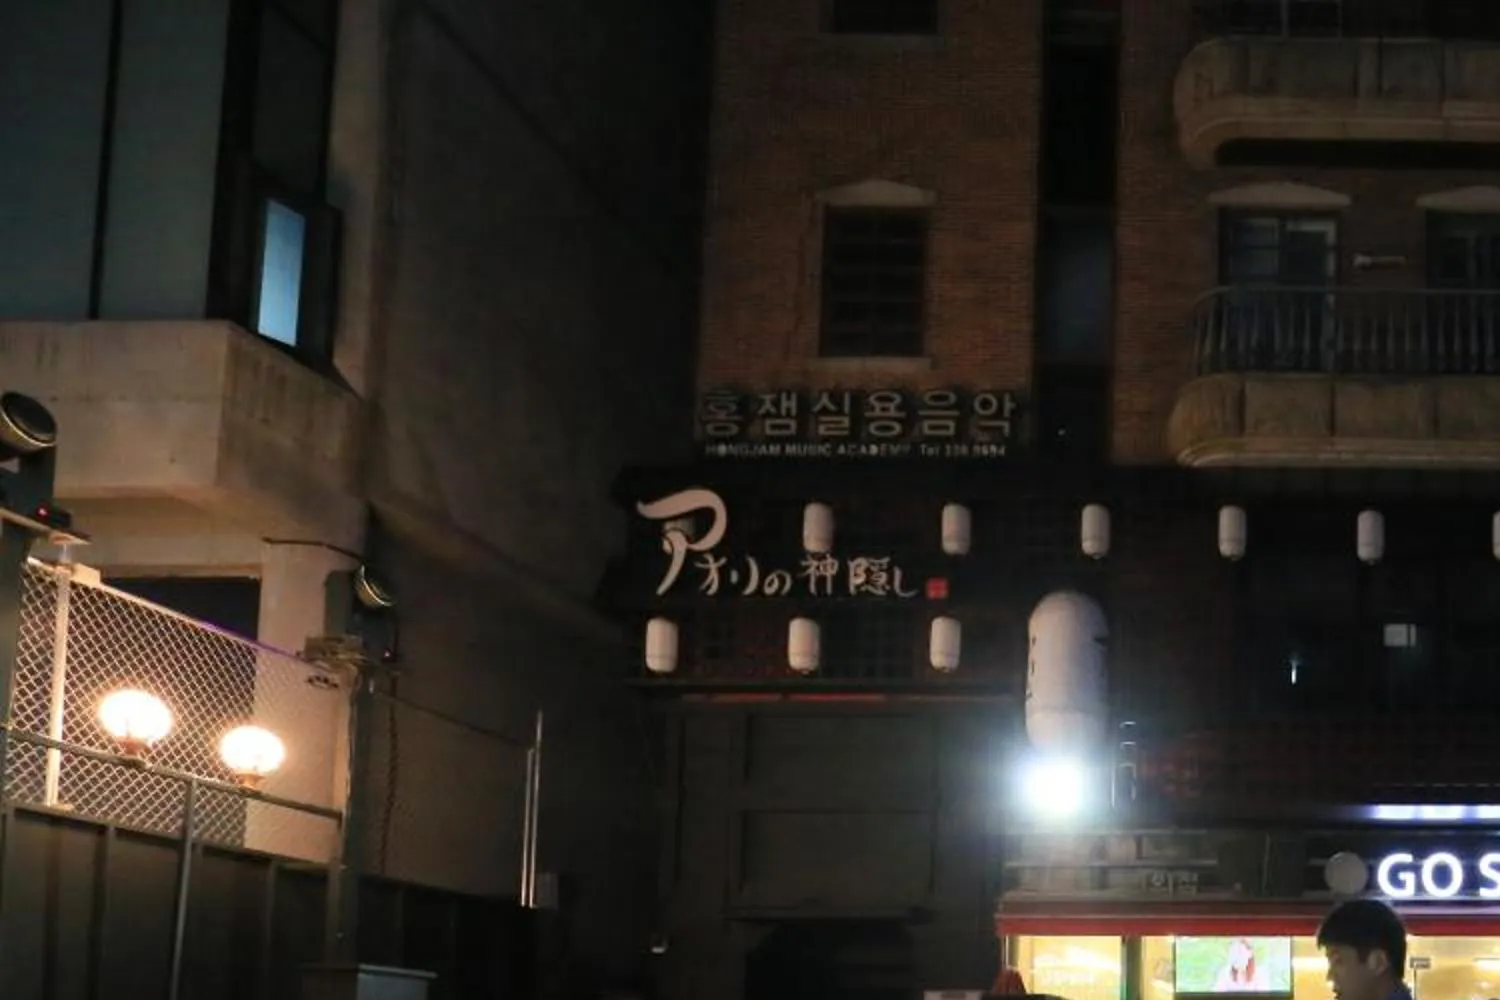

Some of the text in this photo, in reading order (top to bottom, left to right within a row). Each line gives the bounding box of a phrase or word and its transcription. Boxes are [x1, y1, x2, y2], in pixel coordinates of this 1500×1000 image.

[701, 391, 1017, 438] 홍잼실용음악
[785, 443, 832, 458] MUSIC
[1377, 851, 1464, 899] GO
